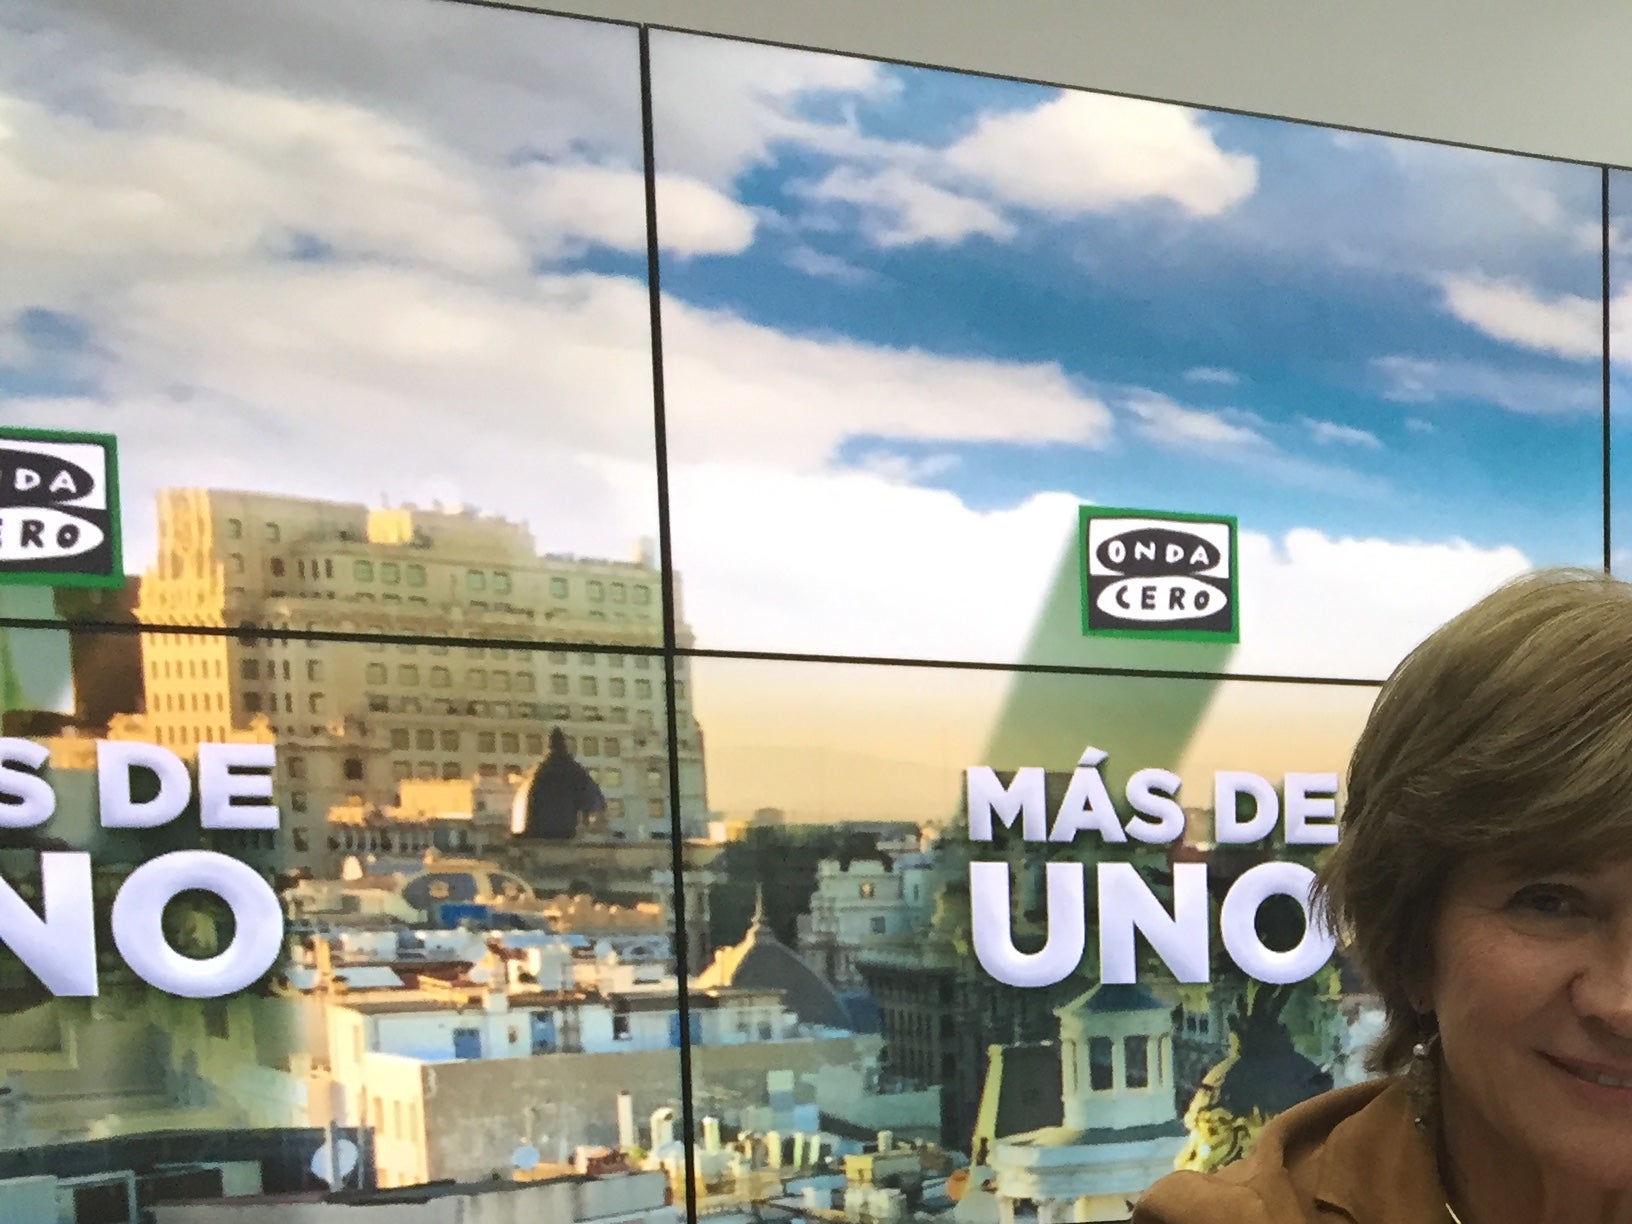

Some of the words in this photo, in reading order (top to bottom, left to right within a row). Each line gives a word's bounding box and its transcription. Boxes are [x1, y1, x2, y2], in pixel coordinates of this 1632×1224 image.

[0, 467, 77, 494] DA
[0, 518, 80, 549] RO
[1106, 538, 1211, 566] ONDA
[1115, 584, 1212, 611] CERO
[96, 739, 280, 830] DE
[966, 745, 1186, 843] MÁS
[1214, 772, 1340, 844] DE
[968, 861, 1337, 988] UNO
